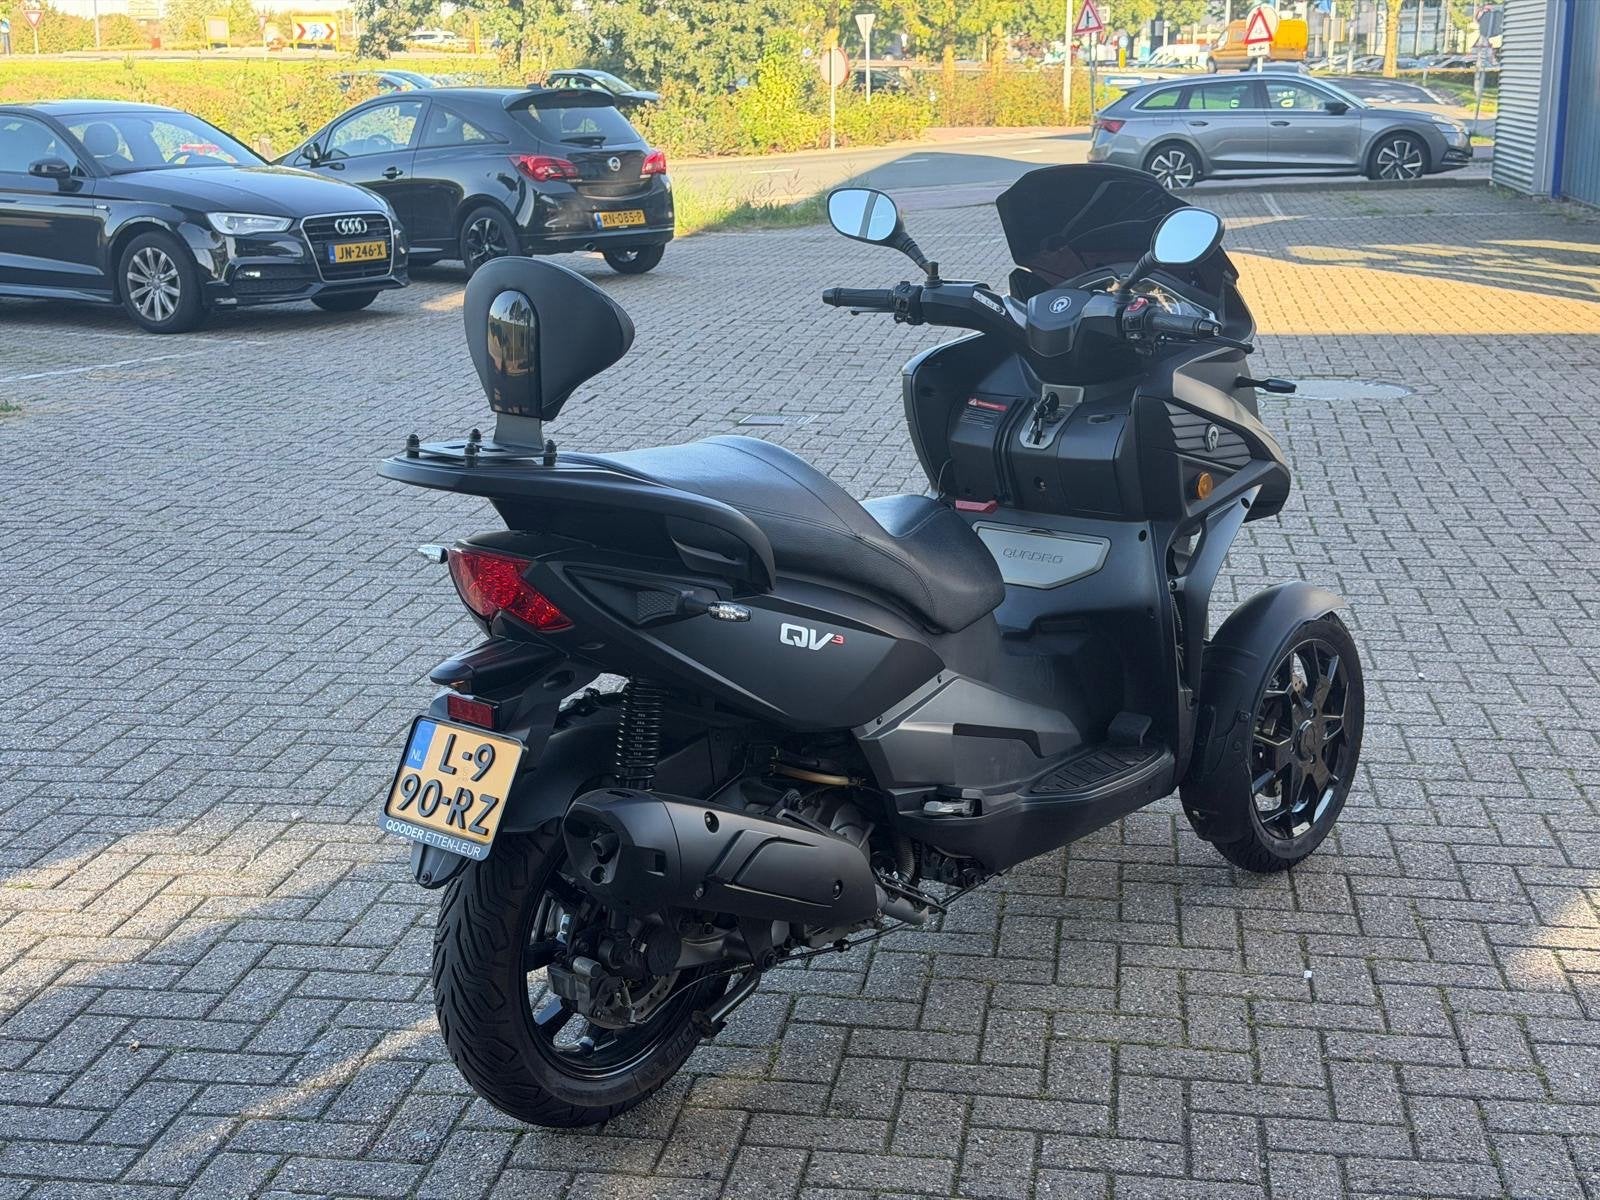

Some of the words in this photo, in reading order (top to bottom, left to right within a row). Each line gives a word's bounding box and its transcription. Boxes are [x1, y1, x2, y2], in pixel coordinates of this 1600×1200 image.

[339, 243, 383, 260] JN-246-X
[1002, 547, 1064, 565] QUADRO
[411, 748, 422, 762] NL
[438, 733, 497, 782] L-9
[396, 773, 500, 836] 90-RZ
[385, 819, 424, 839] QOODER
[424, 831, 481, 858] ETTEN-LEUR
